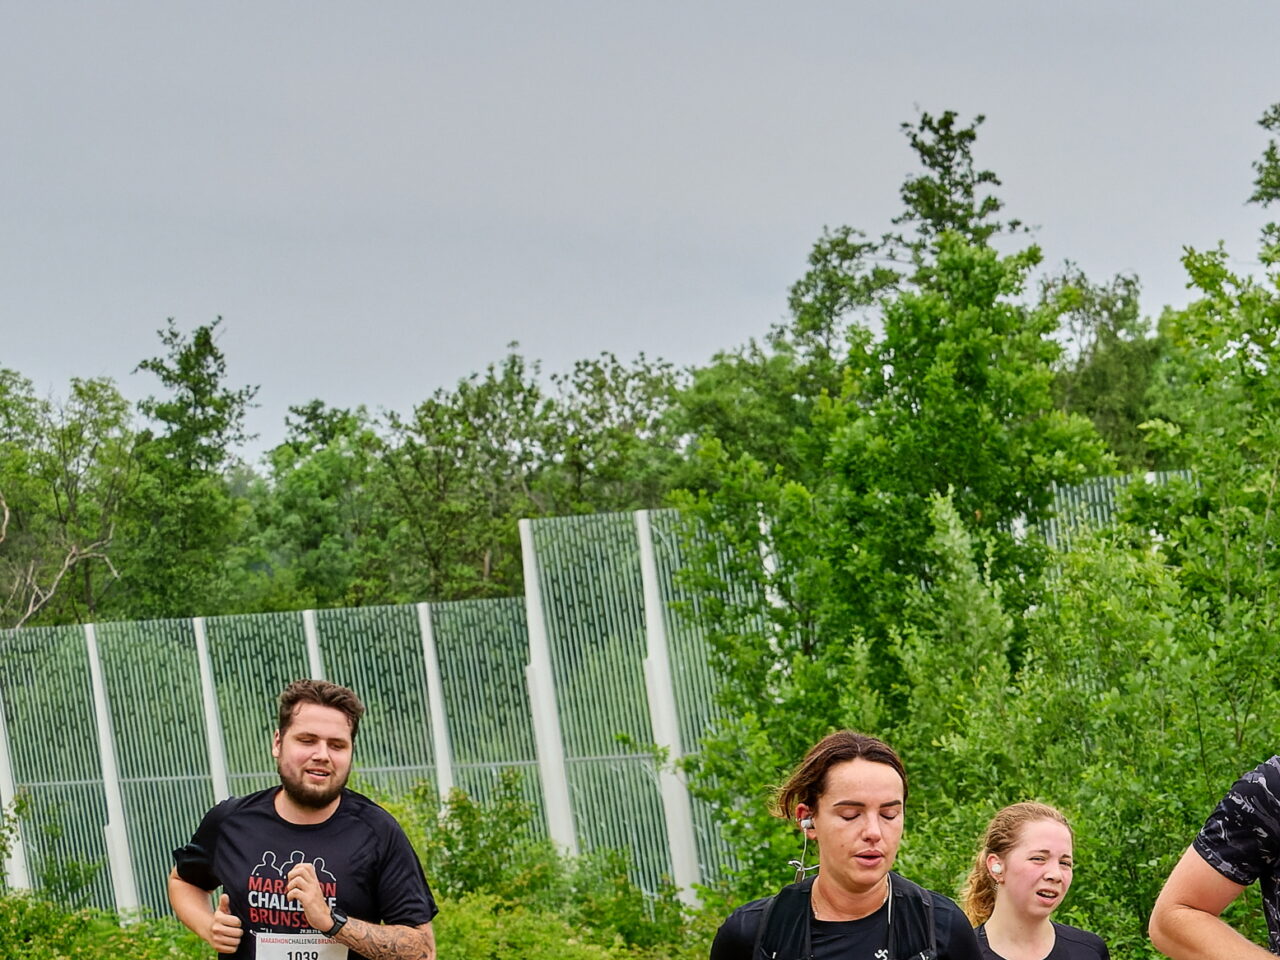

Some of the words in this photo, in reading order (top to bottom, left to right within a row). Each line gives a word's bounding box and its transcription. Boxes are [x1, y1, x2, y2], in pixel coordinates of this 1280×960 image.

[249, 876, 336, 896] MARN
[248, 891, 336, 911] CHALLEE
[249, 908, 310, 927] BRUNSS
